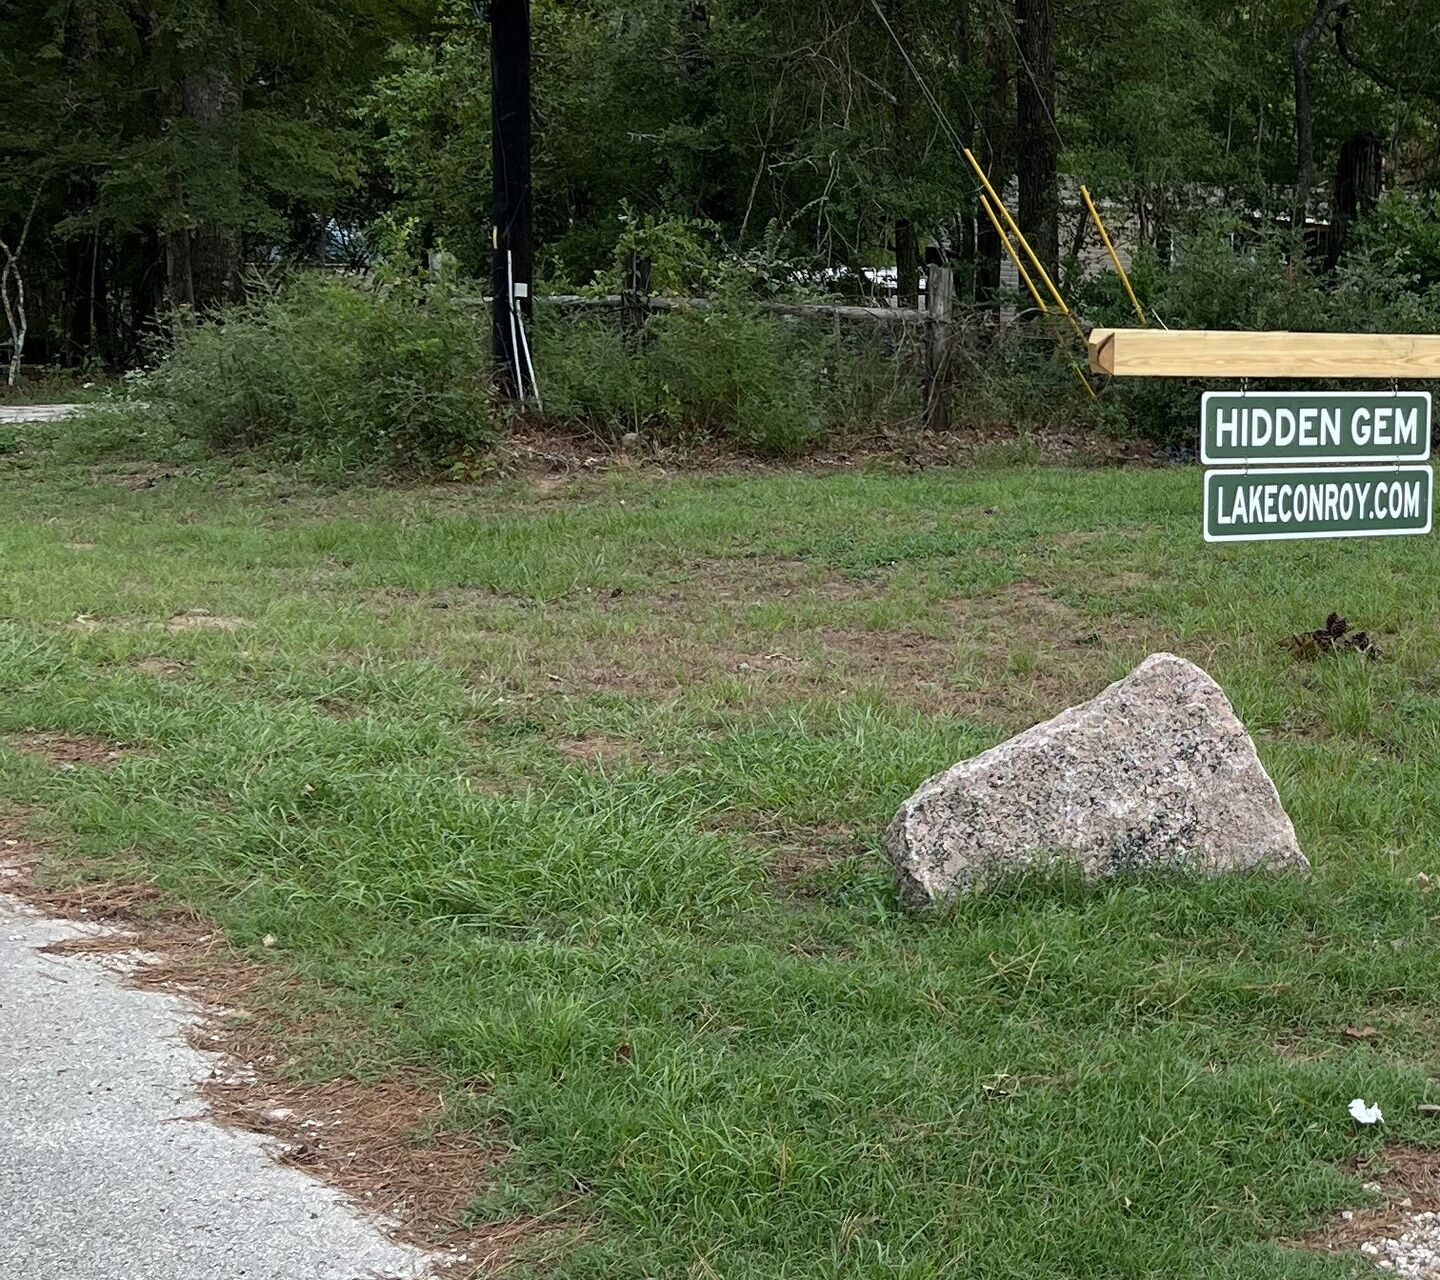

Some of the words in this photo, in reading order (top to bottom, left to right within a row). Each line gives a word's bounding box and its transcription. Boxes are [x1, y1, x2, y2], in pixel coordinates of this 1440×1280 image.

[1216, 407, 1341, 447] HIDDEN
[1351, 407, 1418, 446] GEM
[1217, 480, 1421, 524] LAKECONROY.COM
